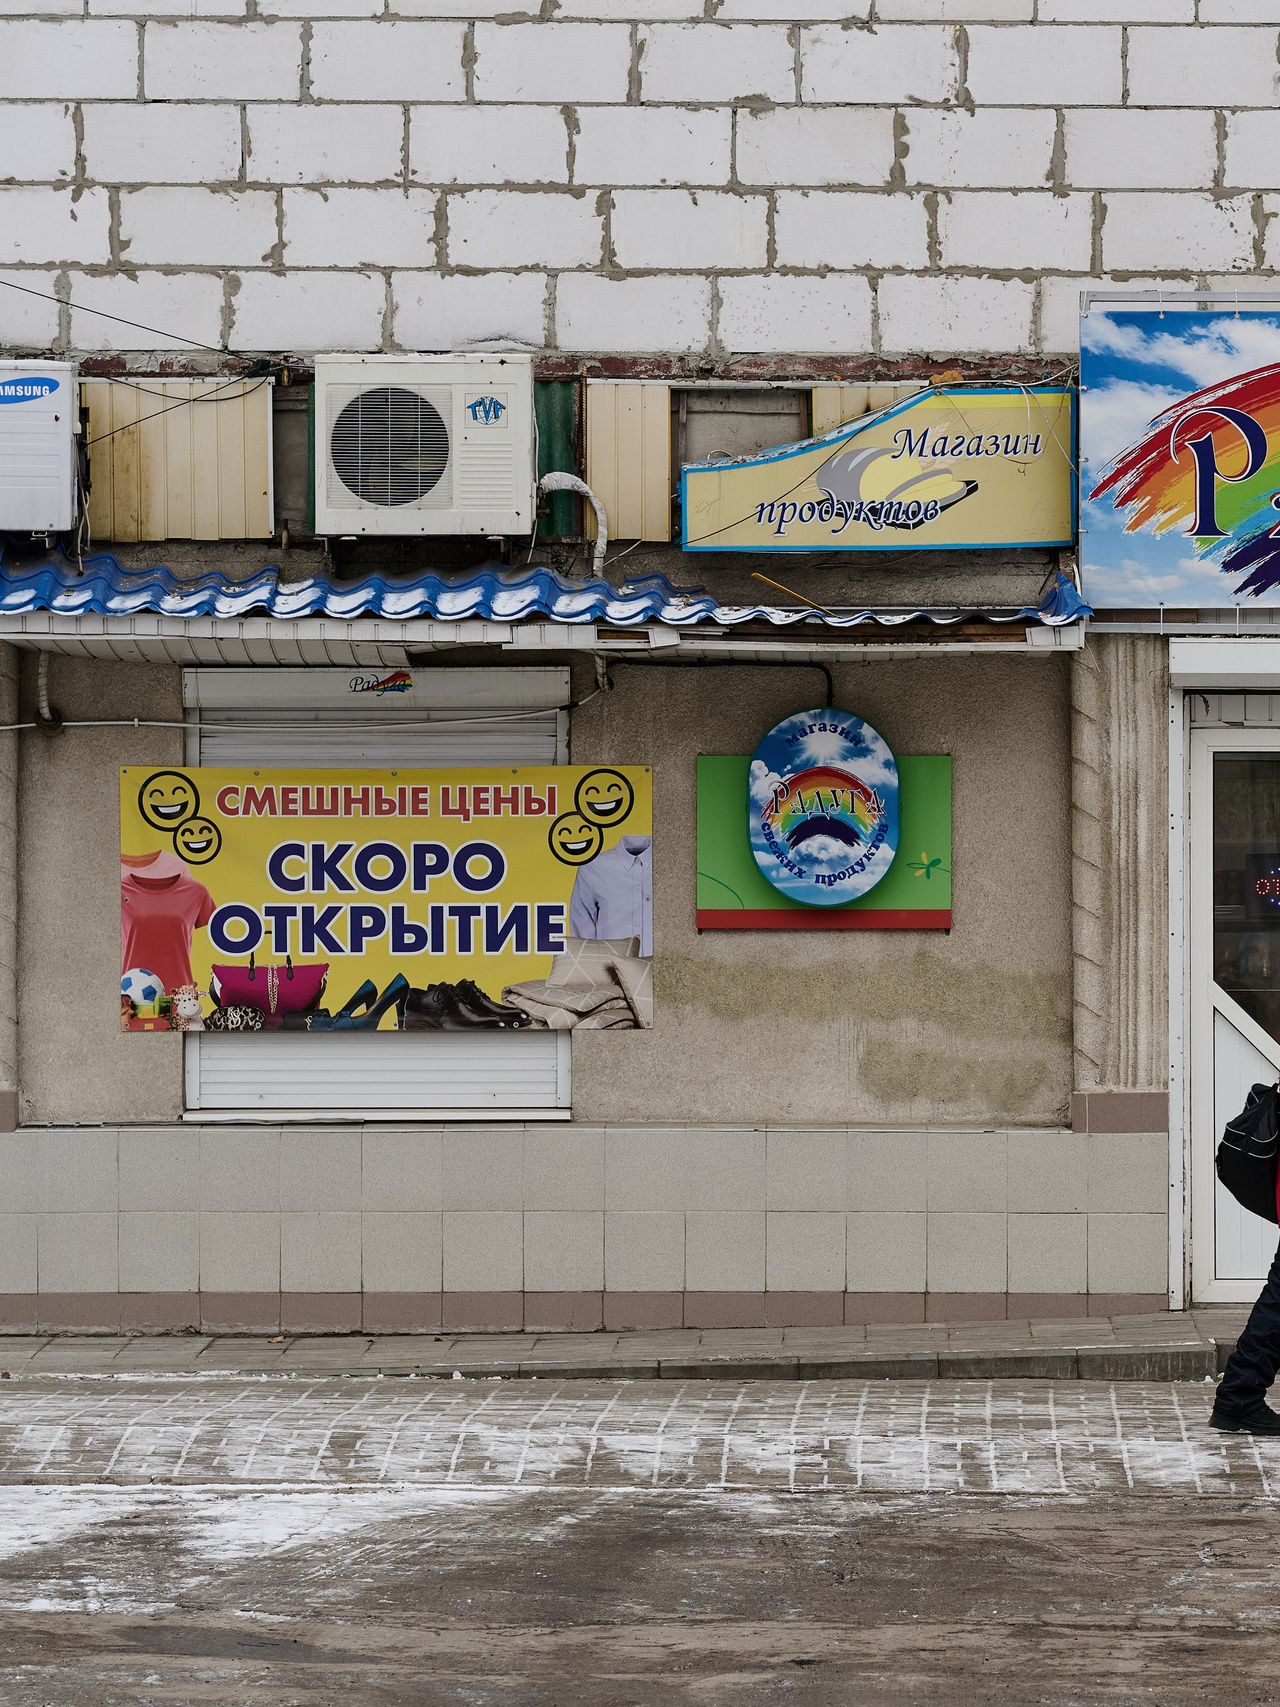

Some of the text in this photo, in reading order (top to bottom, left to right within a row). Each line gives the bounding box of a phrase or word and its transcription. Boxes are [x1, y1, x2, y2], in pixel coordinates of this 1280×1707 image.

[891, 427, 1044, 460] Магазин
[755, 487, 942, 537] продуктов
[784, 722, 863, 748] магазин
[216, 785, 557, 822] СМЕШНЫЕ ЦЕНЫ
[267, 841, 507, 893] СКОРО
[761, 822, 889, 887] свежих продуктов
[208, 903, 567, 955] ОТКРЫТИЕ
